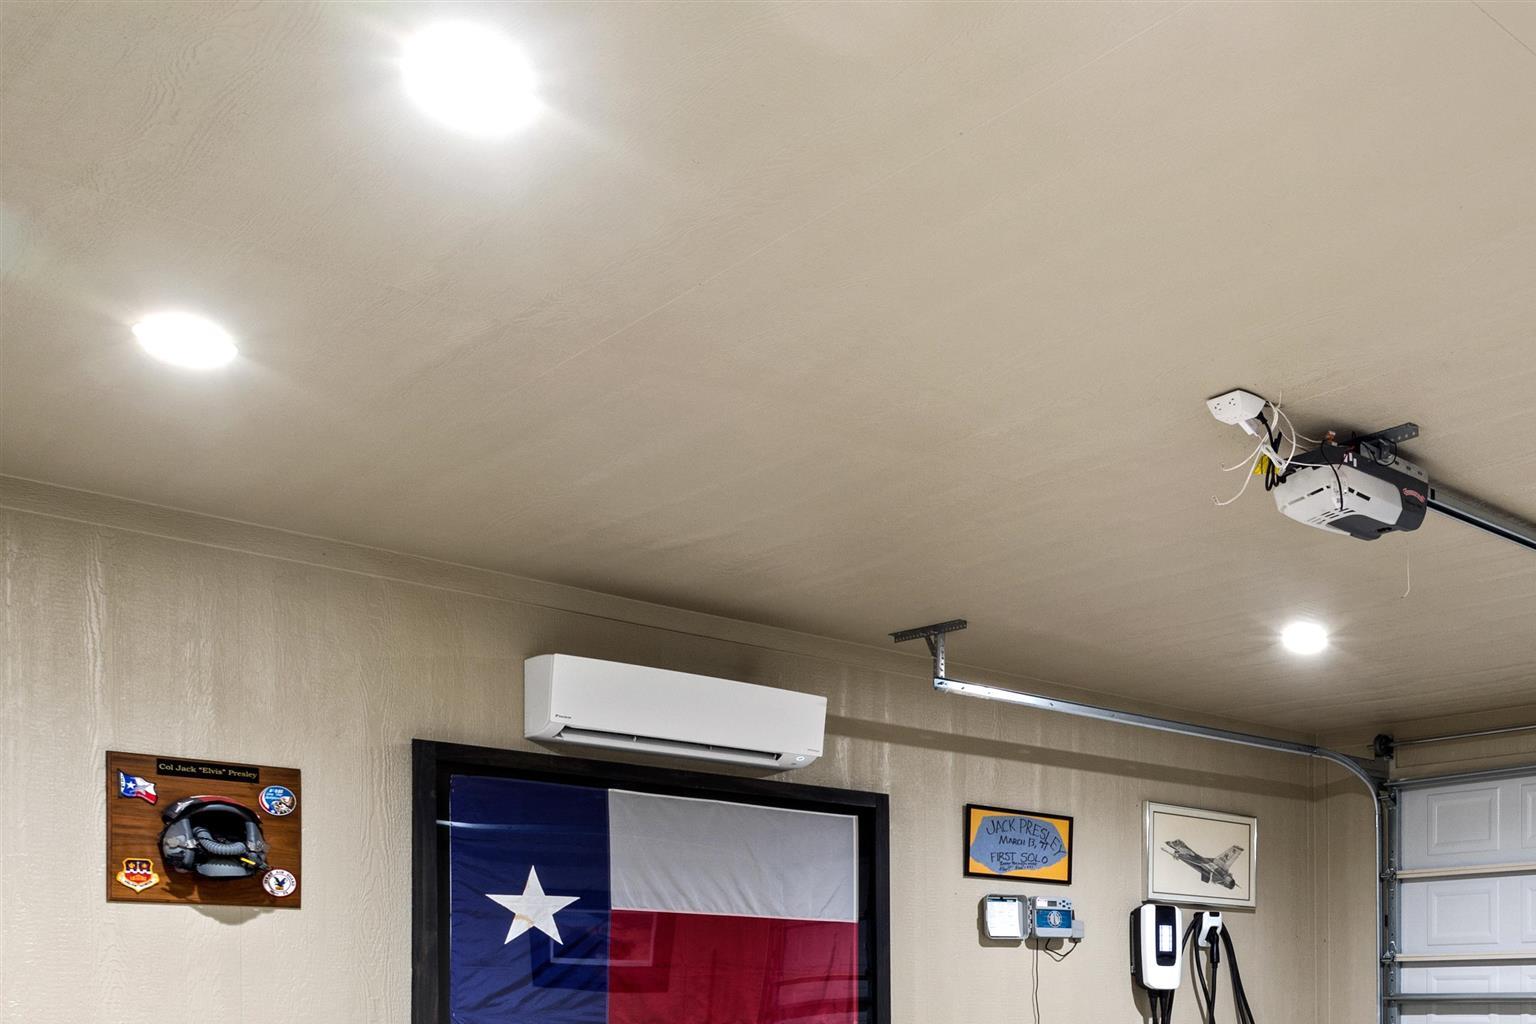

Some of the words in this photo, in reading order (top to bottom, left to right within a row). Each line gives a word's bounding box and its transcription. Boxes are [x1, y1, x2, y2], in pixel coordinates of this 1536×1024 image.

[159, 763, 174, 771] Col
[175, 764, 197, 773] Jack
[228, 769, 258, 779] Presley
[986, 818, 1016, 835] JACK
[1020, 818, 1067, 857] PRESLEY
[990, 851, 1018, 863] FIRST
[1020, 852, 1049, 865] SOLO
